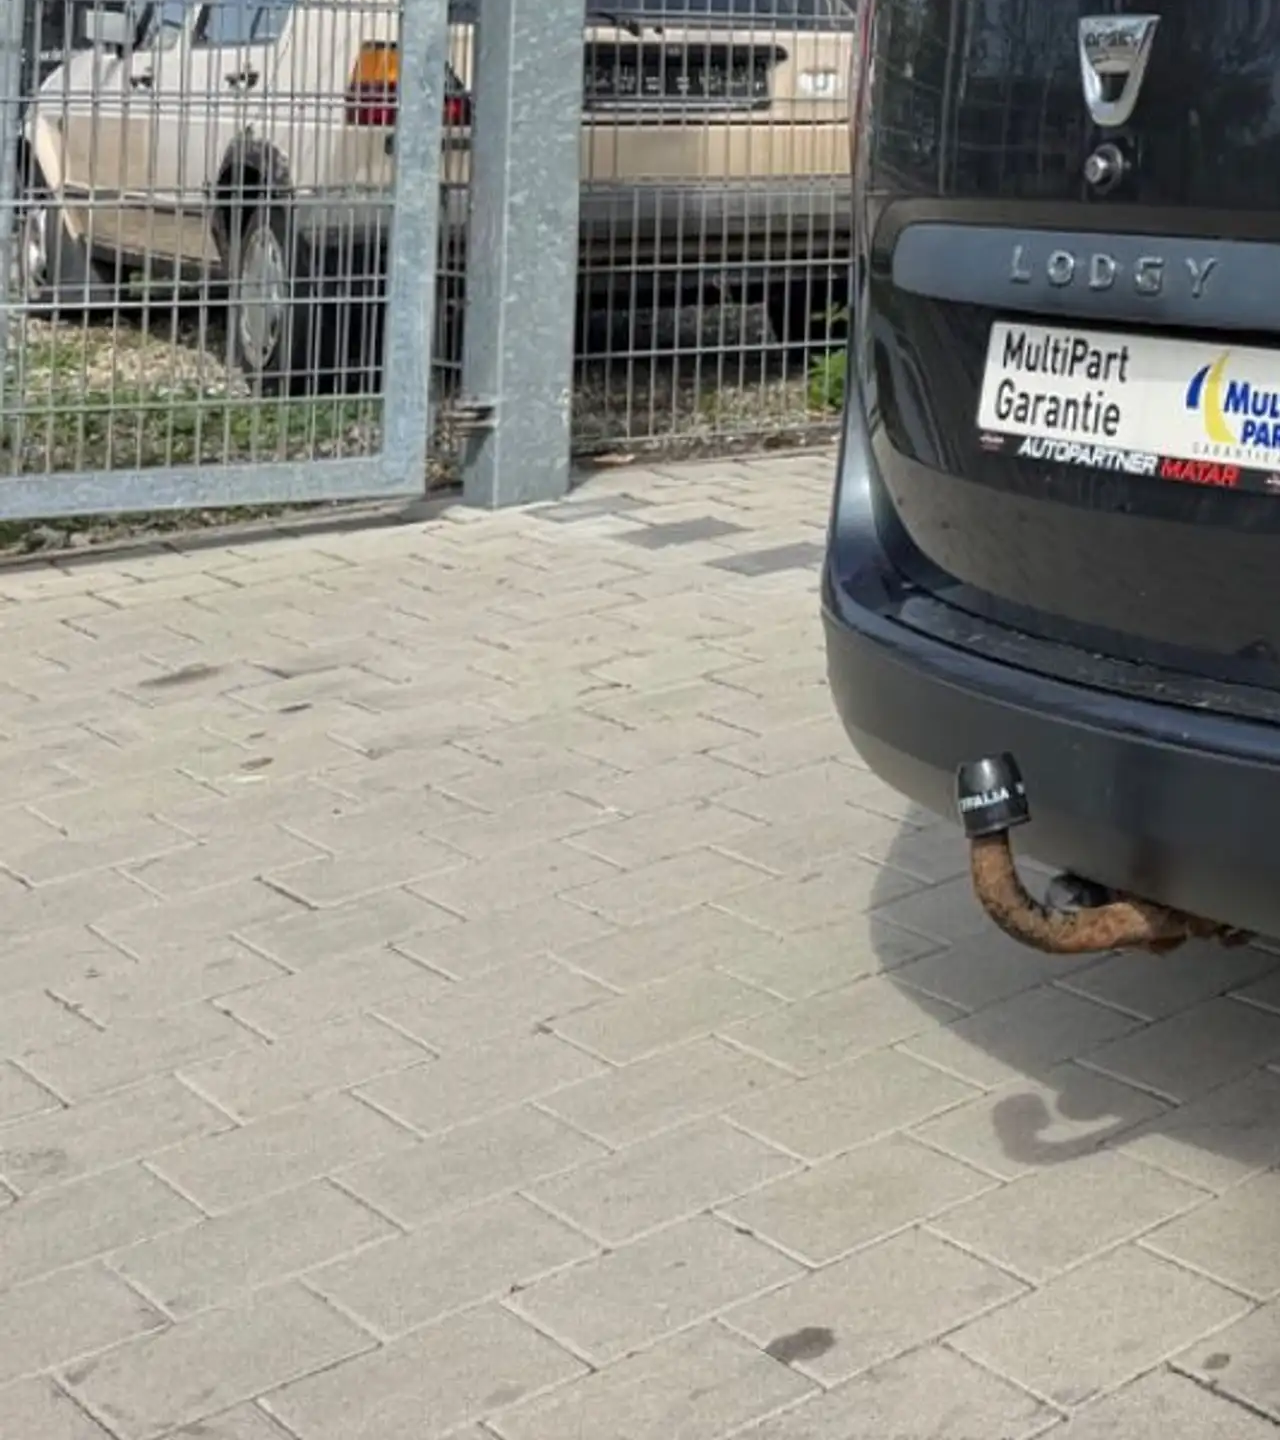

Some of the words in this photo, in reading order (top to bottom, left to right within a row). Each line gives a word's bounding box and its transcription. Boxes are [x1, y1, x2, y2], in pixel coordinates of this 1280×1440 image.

[1010, 244, 1219, 299] LODGY
[1003, 330, 1129, 383] MultiPart
[995, 378, 1120, 436] Garantie
[1018, 436, 1158, 476] AUTOPARTNER
[1160, 457, 1238, 487] MATAR
